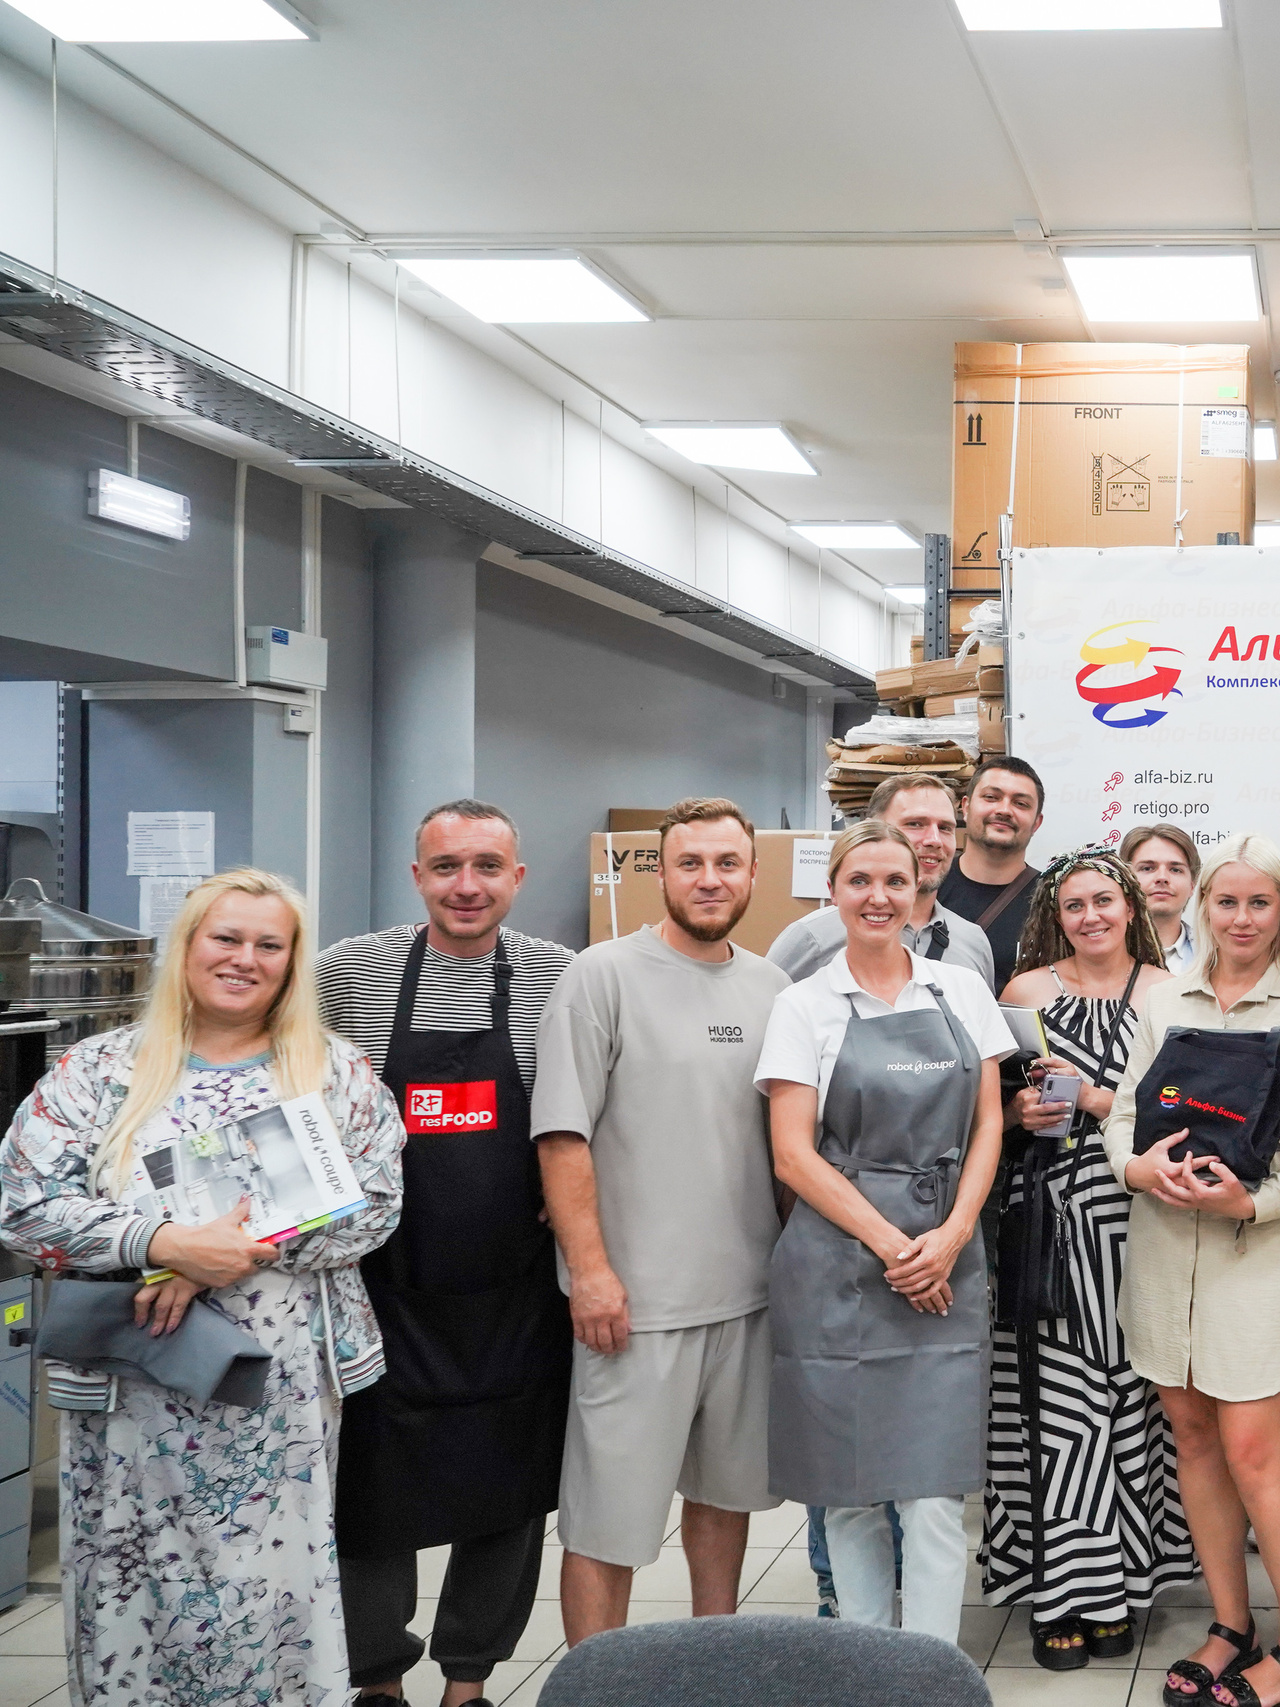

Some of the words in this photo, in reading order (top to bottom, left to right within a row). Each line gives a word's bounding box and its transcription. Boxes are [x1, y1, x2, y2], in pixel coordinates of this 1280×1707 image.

[1074, 408, 1122, 419] FRONT
[1216, 410, 1238, 418] smeg
[1094, 470, 1101, 479] 4
[1094, 481, 1101, 490] 3
[1094, 493, 1101, 502] 2
[1134, 770, 1213, 784] alfa-biz.ru
[1133, 800, 1210, 818] retigo.pro
[1192, 830, 1231, 845] lfa-b
[634, 849, 659, 861] FR
[708, 1026, 743, 1036] HUGO
[886, 1062, 914, 1072] robot
[410, 1093, 442, 1112] RF
[1184, 1097, 1248, 1124] Альфа-Бизнес
[420, 1110, 493, 1127] resFOOD
[299, 1109, 325, 1144] robot
[320, 1156, 345, 1195] coupe
